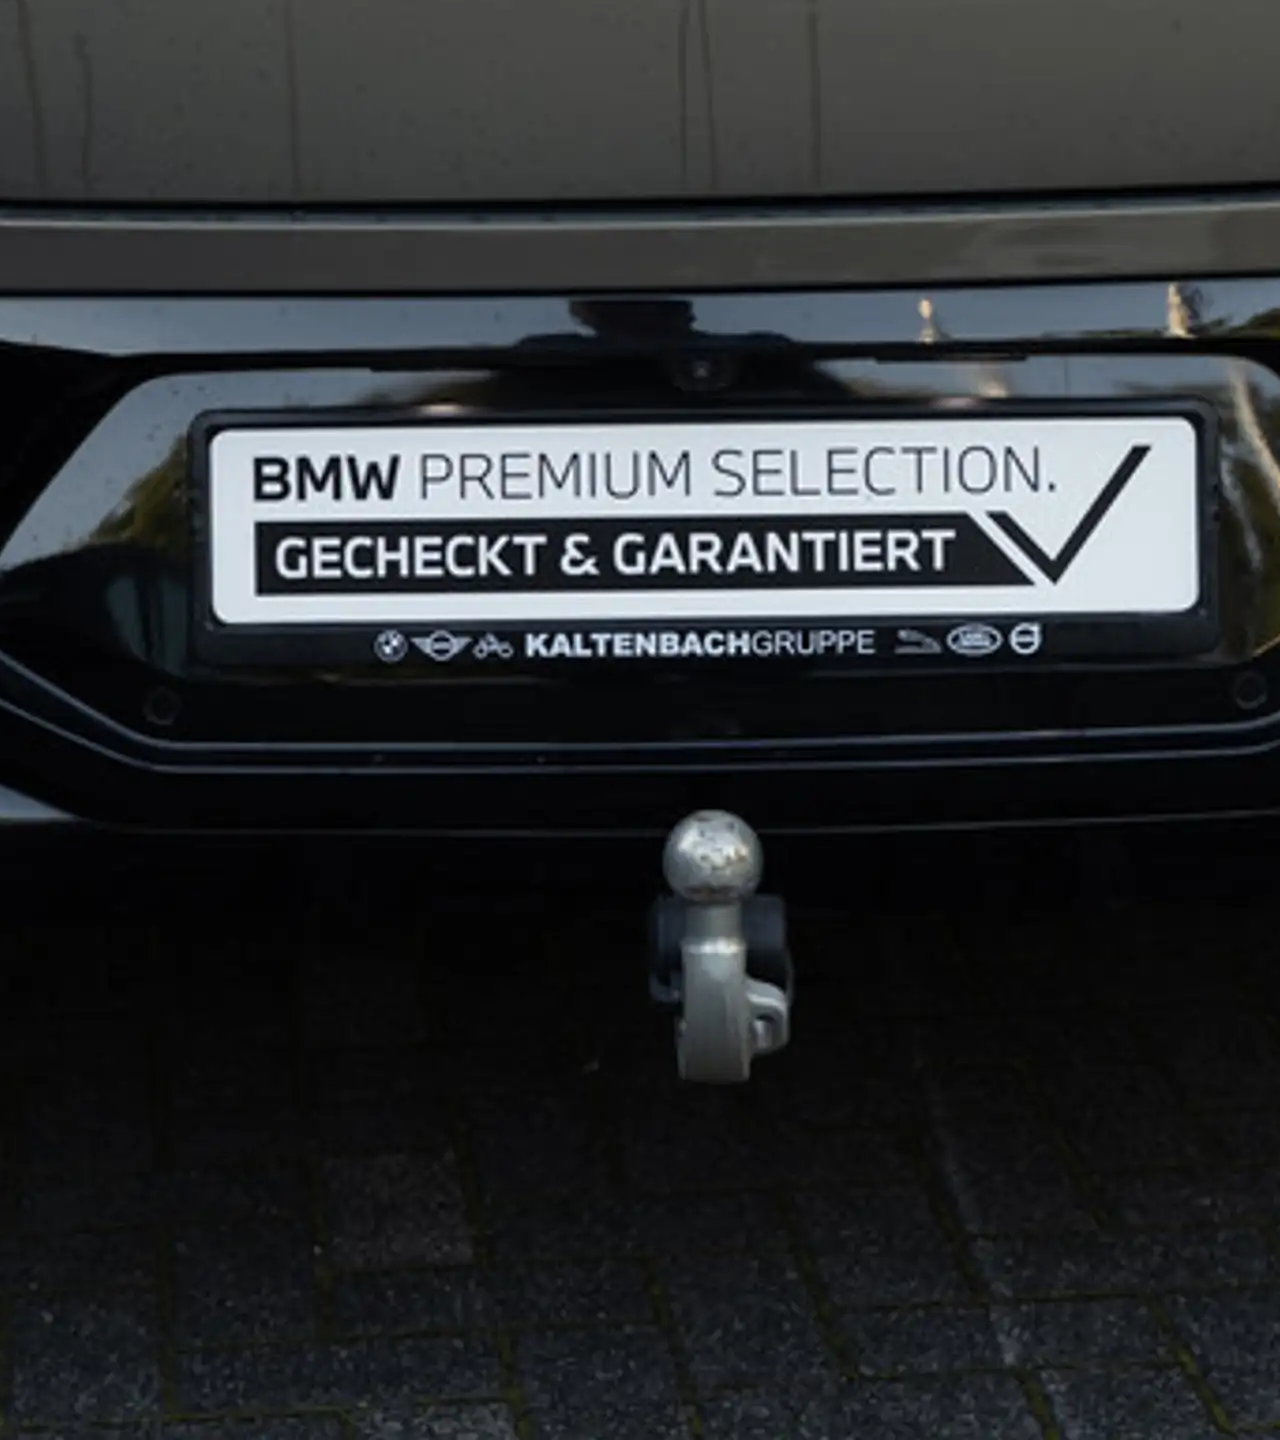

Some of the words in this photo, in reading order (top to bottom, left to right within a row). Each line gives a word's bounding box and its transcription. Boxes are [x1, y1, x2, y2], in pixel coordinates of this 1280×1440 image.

[252, 454, 402, 503] BMW
[420, 450, 691, 500] PREMIUM
[711, 445, 1056, 498] SELECTION.
[275, 534, 548, 579] GECHECKT
[560, 534, 600, 576] &
[613, 529, 957, 575] GARANTIERT
[525, 629, 876, 658] KALTENBACHGRUPPE
